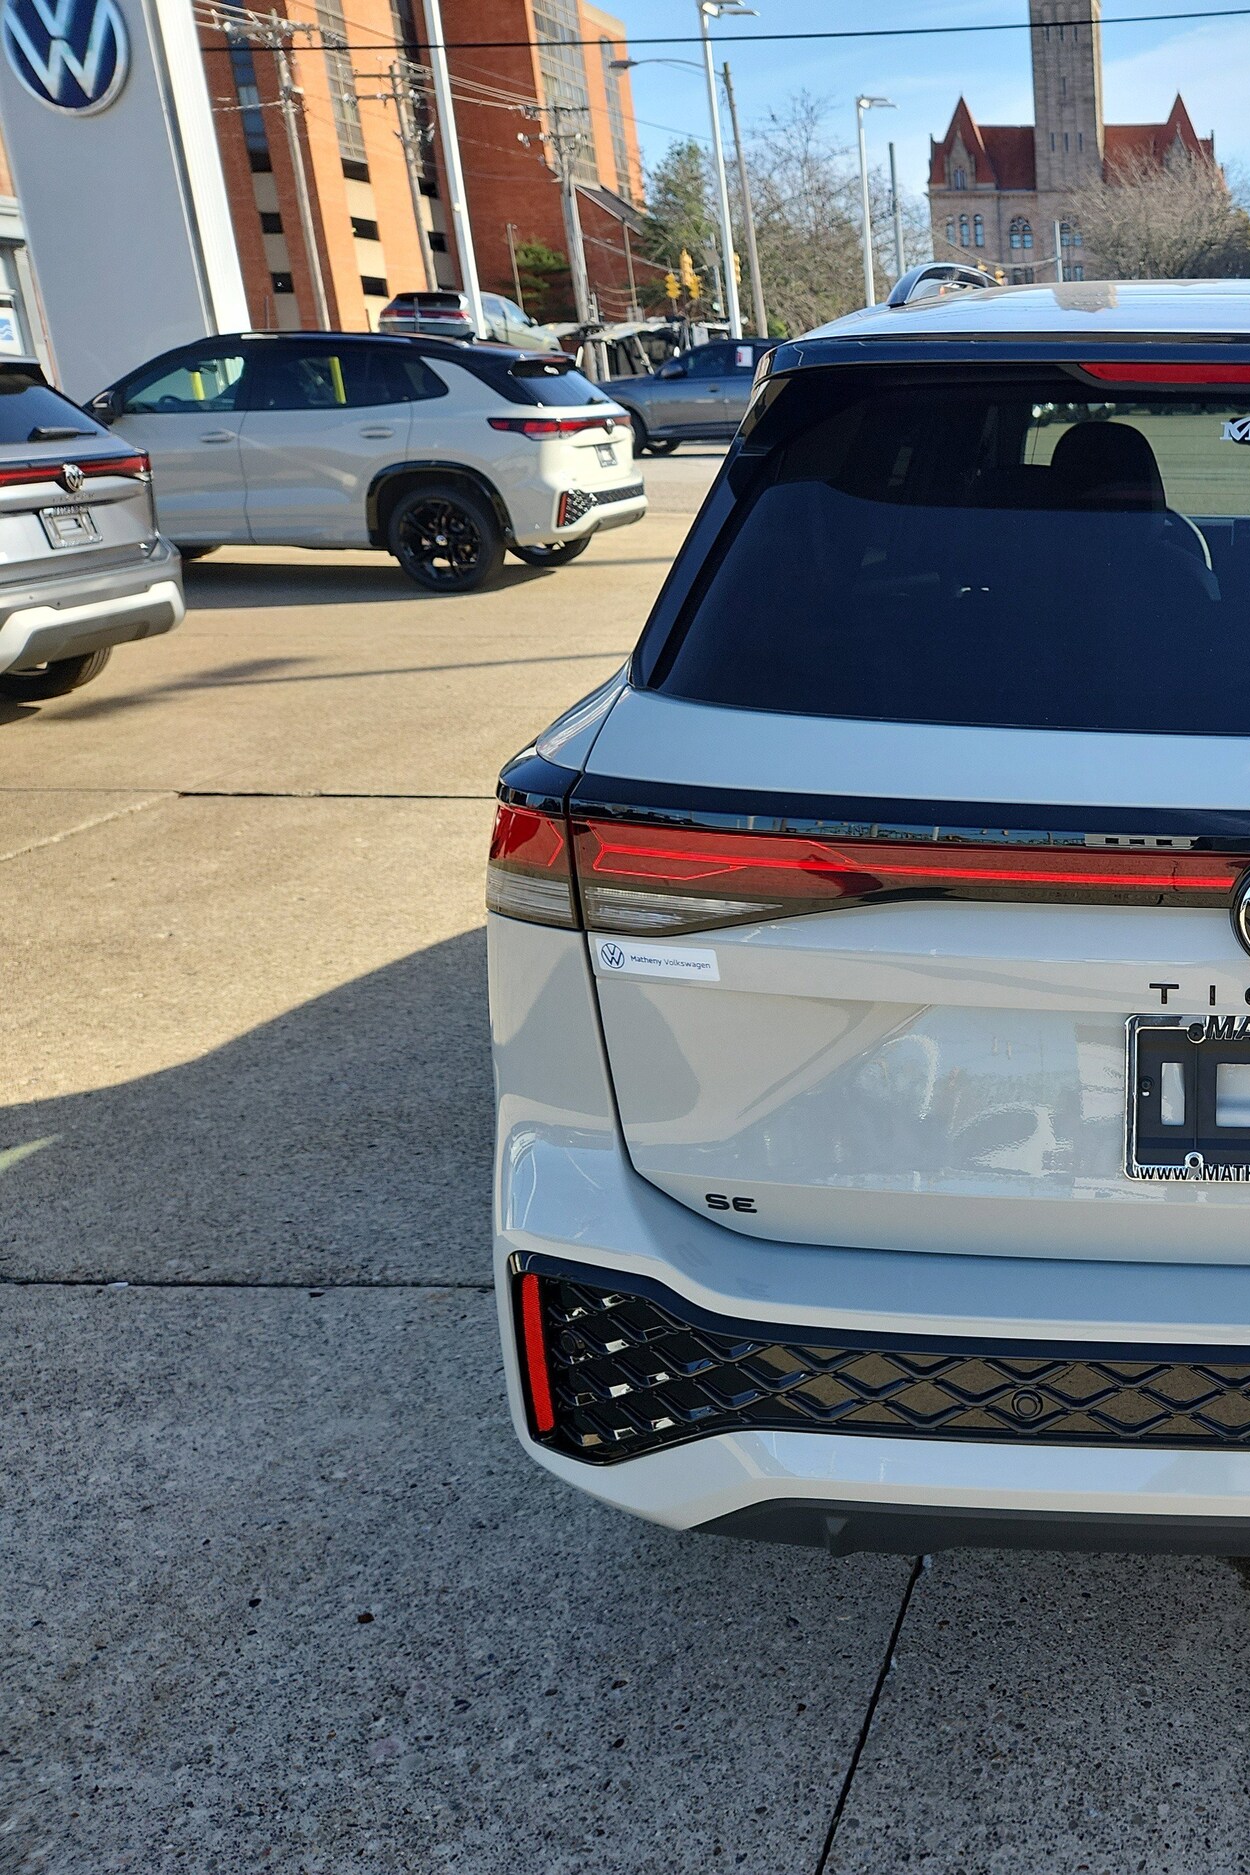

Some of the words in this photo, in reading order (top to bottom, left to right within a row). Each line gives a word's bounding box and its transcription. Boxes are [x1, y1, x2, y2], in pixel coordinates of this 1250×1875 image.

[630, 955, 662, 967] Matheny
[664, 956, 711, 970] Volkswagen
[705, 1193, 758, 1214] SE
